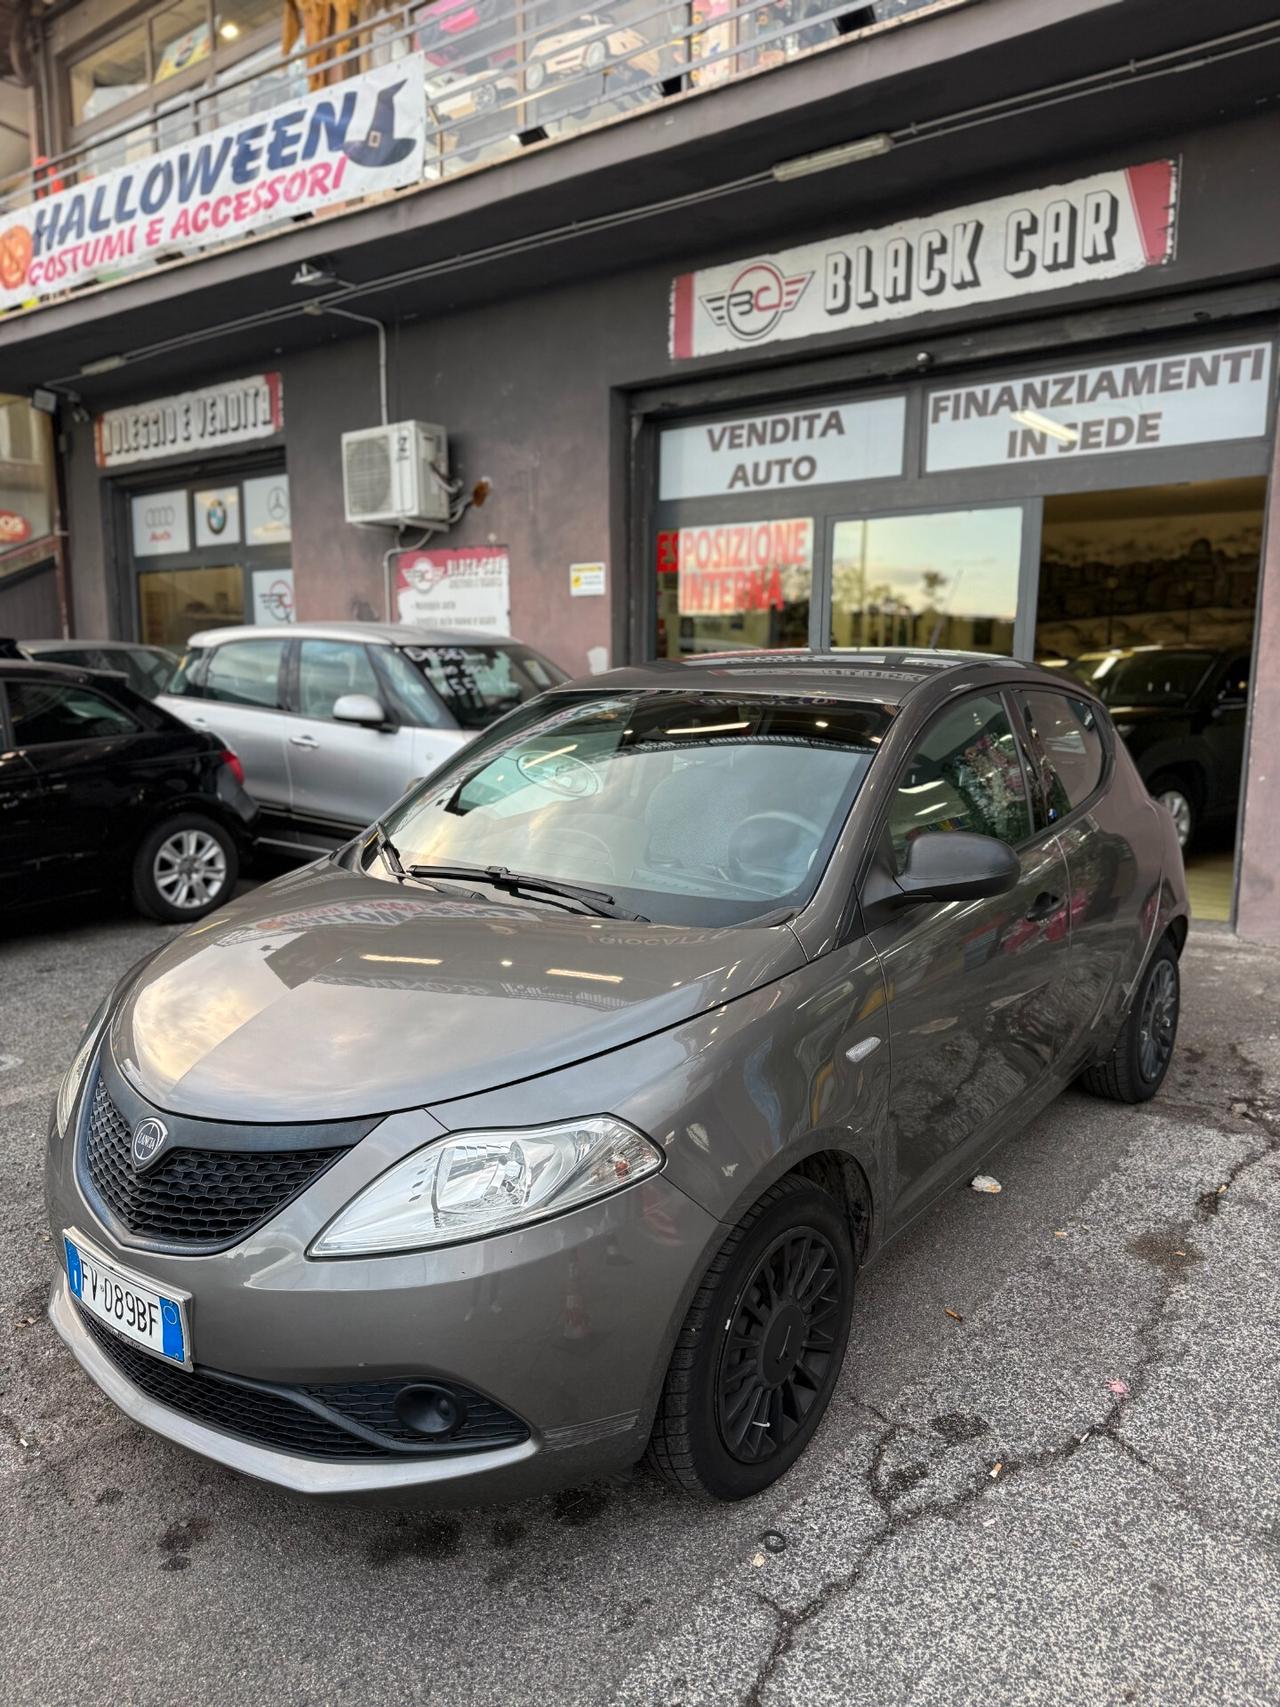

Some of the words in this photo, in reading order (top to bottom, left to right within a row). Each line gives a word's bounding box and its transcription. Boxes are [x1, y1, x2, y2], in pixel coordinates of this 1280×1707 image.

[33, 92, 357, 256] HALLOWEEN
[28, 225, 137, 286] COSTUMI
[146, 217, 164, 246] E
[170, 154, 348, 240] ACCESSORI
[824, 219, 984, 316] BLACK
[1004, 189, 1119, 279] CAR
[930, 348, 1266, 424] FINANZIAMENTI
[706, 410, 845, 452] VENDITA
[1006, 425, 1047, 459] IN
[726, 455, 817, 489] AUTO
[656, 521, 808, 573] ESPOSIZIONE
[681, 566, 784, 612] INTERNA
